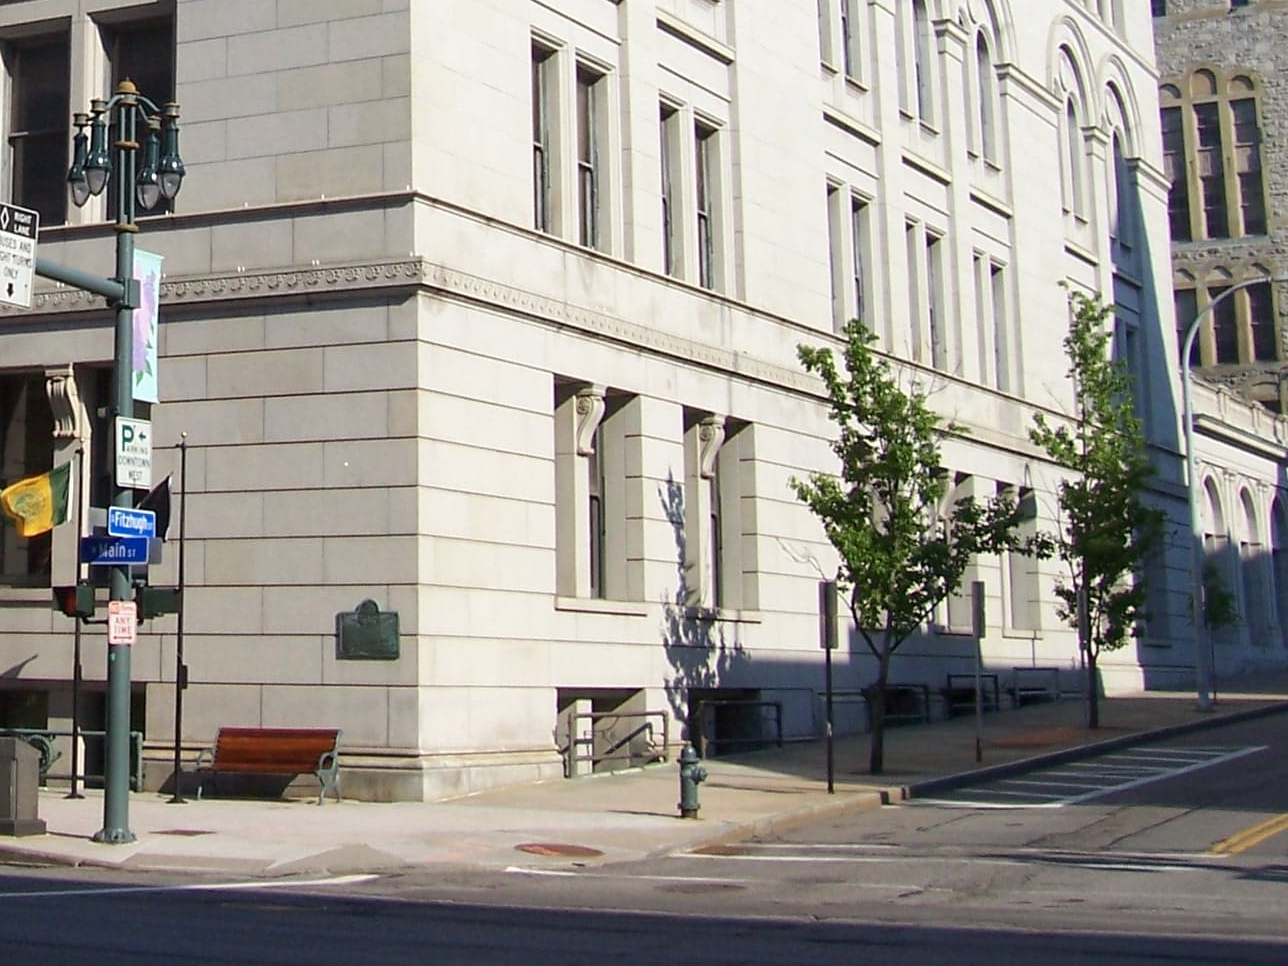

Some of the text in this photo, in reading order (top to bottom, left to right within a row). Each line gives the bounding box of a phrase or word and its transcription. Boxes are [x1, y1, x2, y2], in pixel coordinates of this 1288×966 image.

[14, 211, 32, 224] RIGHT
[14, 223, 30, 236] LANE
[19, 240, 31, 254] AND
[118, 455, 150, 468] DOWNTOWN
[115, 511, 148, 535] Fitzhugh
[99, 542, 126, 558] Main
[127, 548, 136, 558] ST
[115, 617, 130, 625] ANY
[114, 625, 131, 634] TIME
